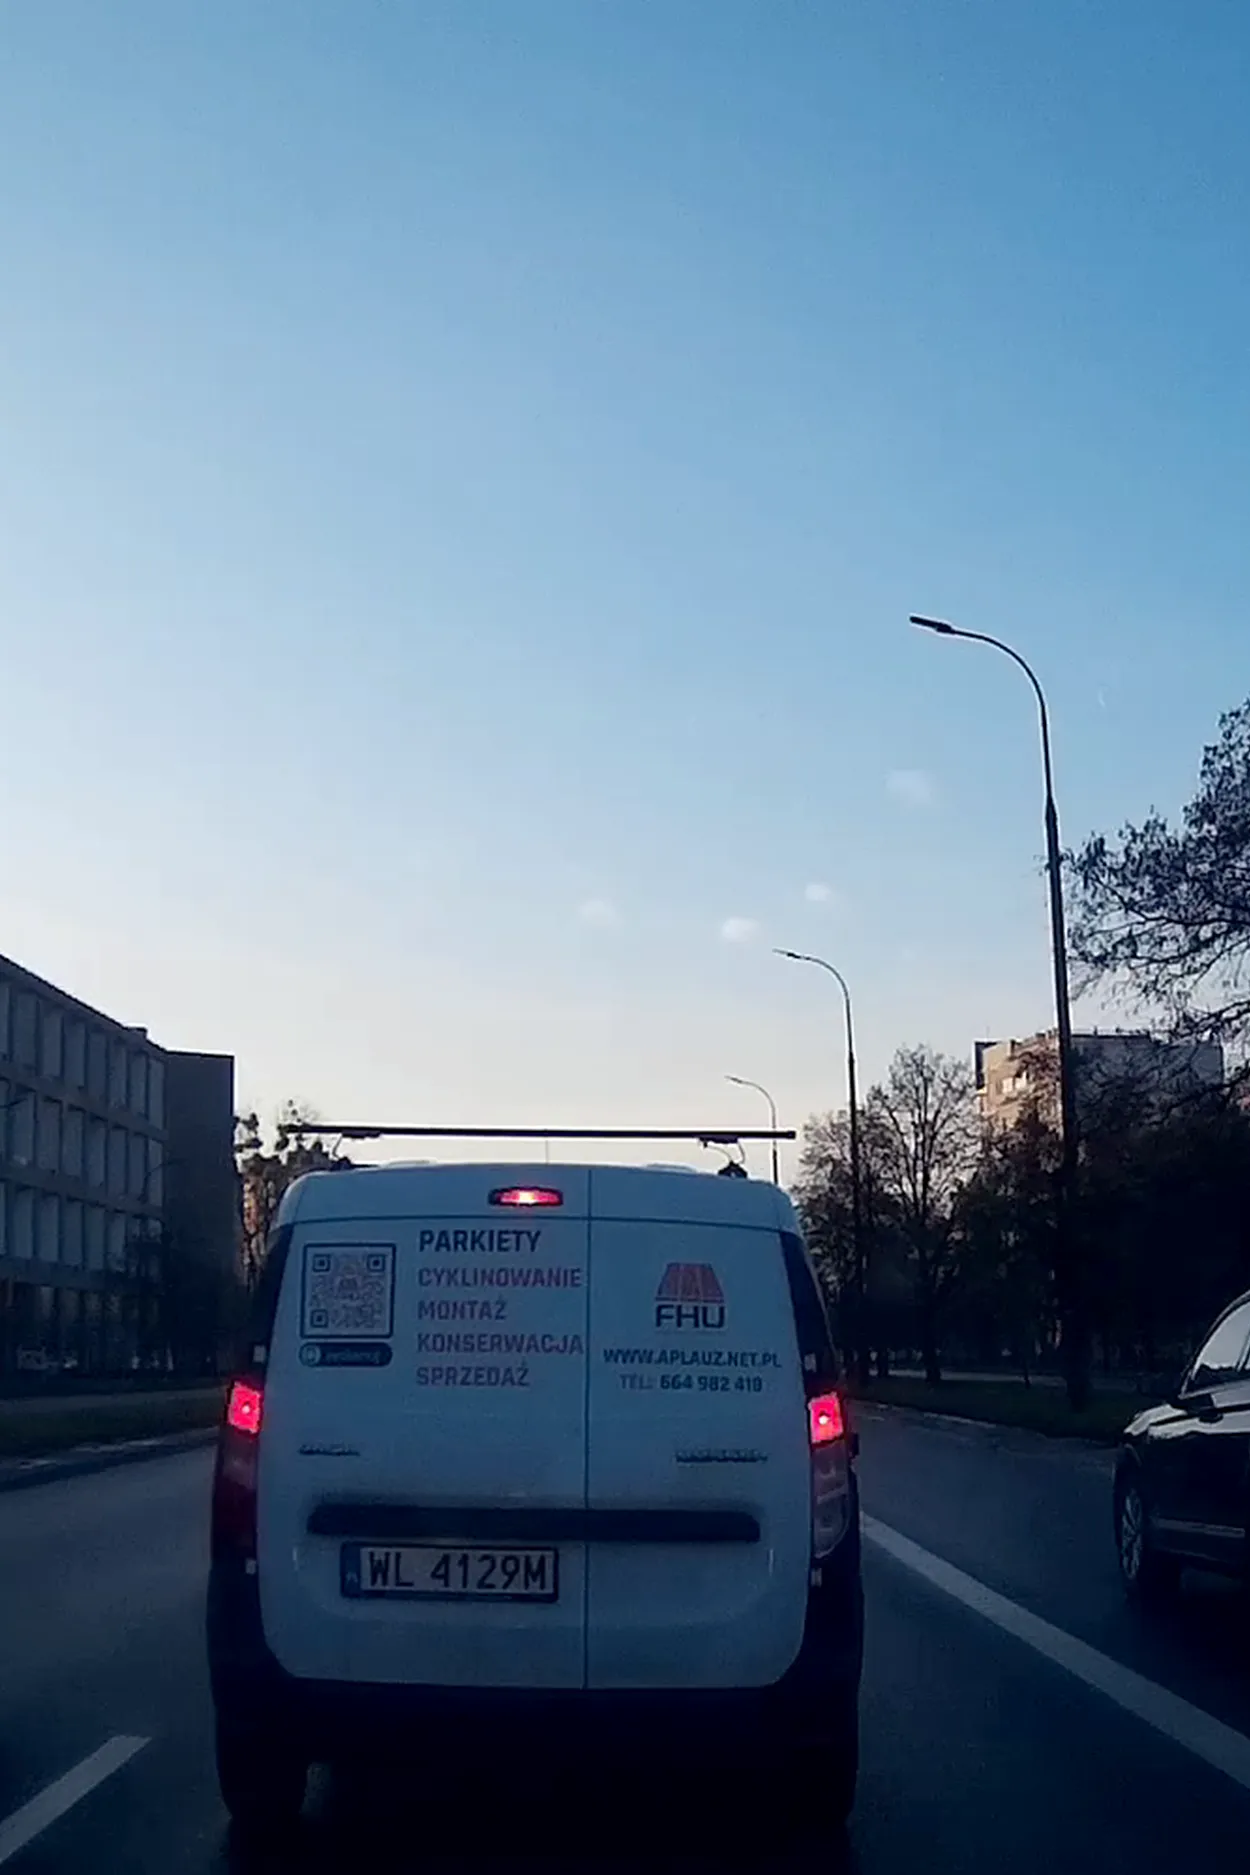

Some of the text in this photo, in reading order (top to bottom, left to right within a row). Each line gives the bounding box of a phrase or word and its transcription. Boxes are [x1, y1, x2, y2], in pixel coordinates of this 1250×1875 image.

[418, 1229, 542, 1252] PARKIETY
[417, 1267, 583, 1288] CYKLINOWANIE
[417, 1294, 507, 1320] MONTAŻ
[655, 1304, 725, 1328] FHU
[416, 1332, 584, 1354] KONSERWACJA
[602, 1349, 783, 1369] WWW.APLAUZ.NET.PL
[416, 1356, 530, 1387] SPRZEDAŻ
[659, 1373, 693, 1390] 664
[697, 1375, 731, 1391] 982
[369, 1551, 546, 1590] WL 4129M
